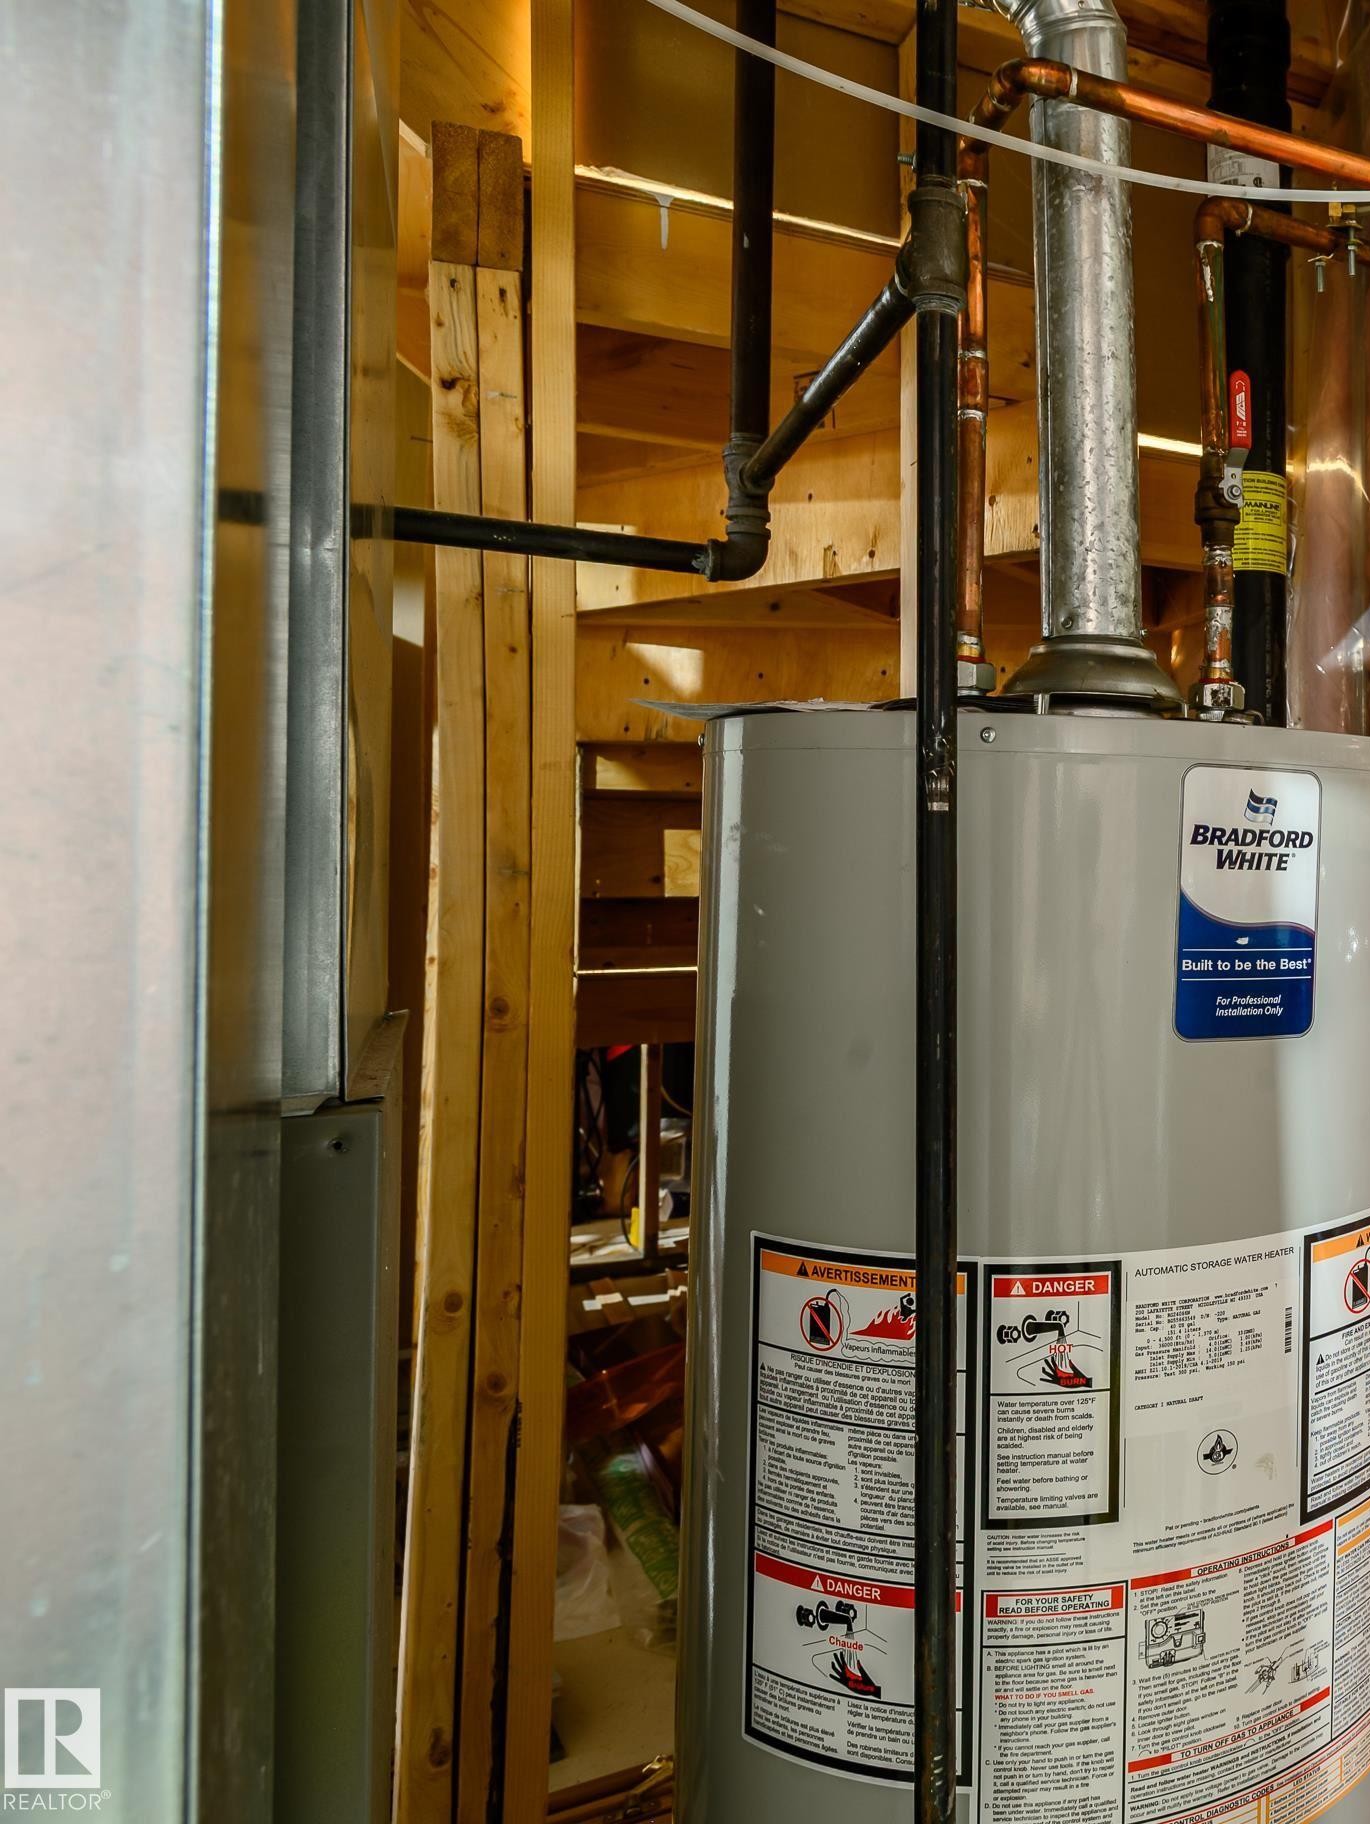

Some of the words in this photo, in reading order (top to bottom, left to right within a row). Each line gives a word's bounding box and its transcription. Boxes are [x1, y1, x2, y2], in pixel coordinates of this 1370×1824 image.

[1190, 823, 1314, 849] BRADFORD
[1216, 849, 1290, 871] WHITE
[1182, 959, 1213, 971] Built
[1217, 960, 1231, 971] to
[1235, 959, 1252, 971] be
[1256, 959, 1276, 971] the
[1280, 958, 1308, 970] Best
[1216, 996, 1231, 1006] For
[1232, 994, 1281, 1006] Professional
[1215, 1006, 1263, 1017] Installation
[1264, 1005, 1283, 1018] Only
[1135, 1265, 1188, 1277] AUTOMATIC
[1190, 1258, 1232, 1271] STORAGE
[1234, 1253, 1263, 1265] WATER
[1265, 1247, 1294, 1259] HEATER
[811, 1266, 916, 1288] AVERTISSEMENT
[1032, 1280, 1095, 1294] DANGER
[1342, 1329, 1353, 1339] FIRE
[1354, 1325, 1364, 1335] AND
[844, 1342, 870, 1353] Vapeurs
[1049, 1344, 1073, 1354] HOT
[791, 1354, 814, 1365] RISQUE
[816, 1358, 853, 1371] D'INCENDIE
[854, 1363, 864, 1372] ET
[866, 1365, 916, 1378] D'EXPLOSION
[794, 1362, 805, 1371] Peut
[807, 1366, 824, 1374] causer
[825, 1367, 833, 1375] des
[835, 1369, 861, 1380] blessures
[862, 1374, 881, 1383] graves
[1072, 1424, 1093, 1432] elderly
[1018, 1434, 1041, 1442] highest
[848, 1458, 858, 1466] Les
[1020, 1459, 1059, 1467] temperature
[1197, 1558, 1240, 1575] OPERATING
[1242, 1542, 1289, 1563] INSTRUCTIONS
[827, 1580, 881, 1600] DANGER
[1062, 1594, 1094, 1603] SAFETY
[1025, 1605, 1058, 1613] BEFORE
[1062, 1601, 1109, 1612] OPERATING
[829, 1636, 863, 1651] Chaude
[1181, 1750, 1192, 1758] TO
[1193, 1745, 1213, 1756] TURN
[1215, 1739, 1229, 1749] OFF
[1231, 1734, 1246, 1744] GAS
[1248, 1729, 1257, 1738] TO
[1258, 1710, 1294, 1734] APPLIANCE
[1207, 1797, 1250, 1818] DIAGNOSTIC
[1251, 1784, 1274, 1801] CODES
